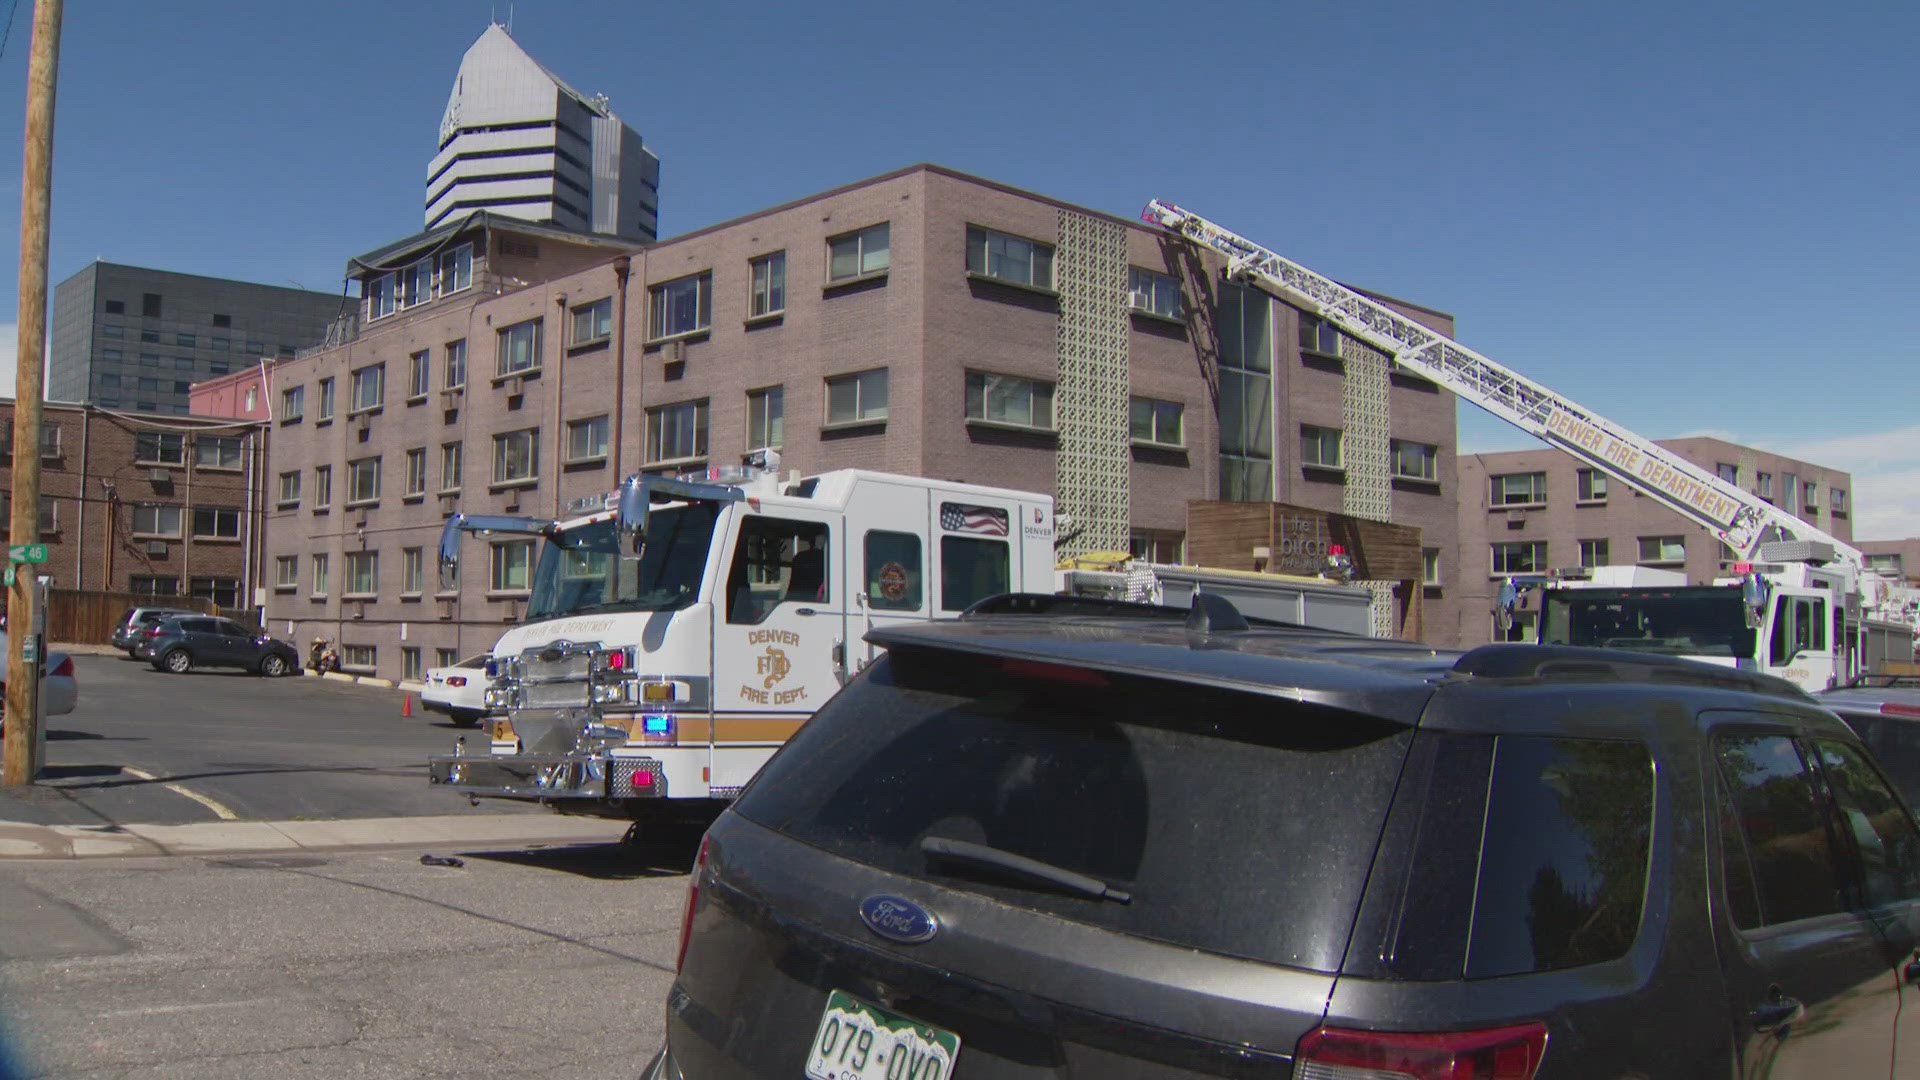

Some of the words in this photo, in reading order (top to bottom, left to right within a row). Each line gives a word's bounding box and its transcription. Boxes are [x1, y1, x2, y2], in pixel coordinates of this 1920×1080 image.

[1547, 410, 1603, 451] DENVER
[1604, 440, 1641, 470] FIRE
[1639, 460, 1736, 521] DEPARTMENT
[1024, 525, 1052, 537] DENVER
[1292, 514, 1310, 531] the
[1280, 514, 1327, 556] birch
[748, 629, 800, 647] DENVER
[740, 685, 769, 704] FIRE
[774, 686, 808, 704] DEPT.
[496, 720, 504, 740] 5
[872, 901, 917, 932] Ford
